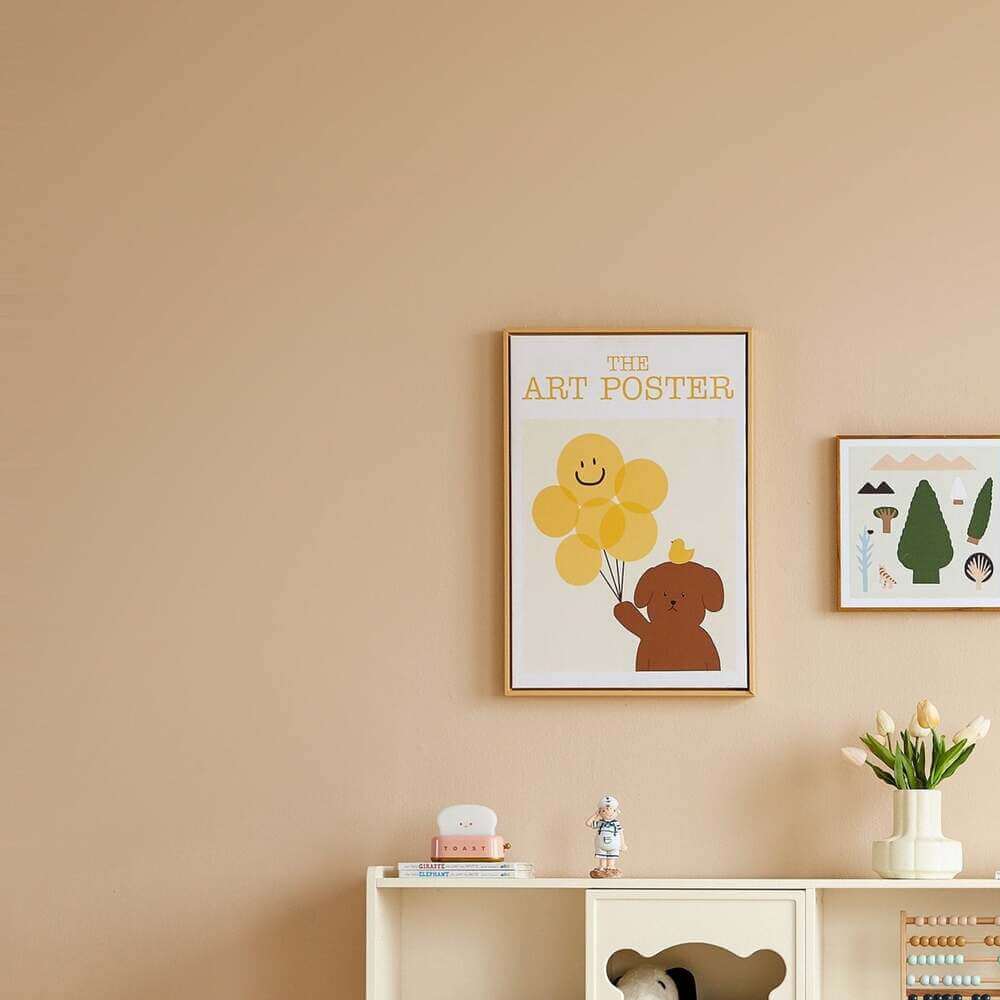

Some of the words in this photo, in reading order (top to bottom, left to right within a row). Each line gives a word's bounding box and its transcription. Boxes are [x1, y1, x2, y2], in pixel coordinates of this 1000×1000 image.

[606, 355, 649, 371] THE
[522, 376, 588, 400] ART
[600, 376, 734, 401] POSTER
